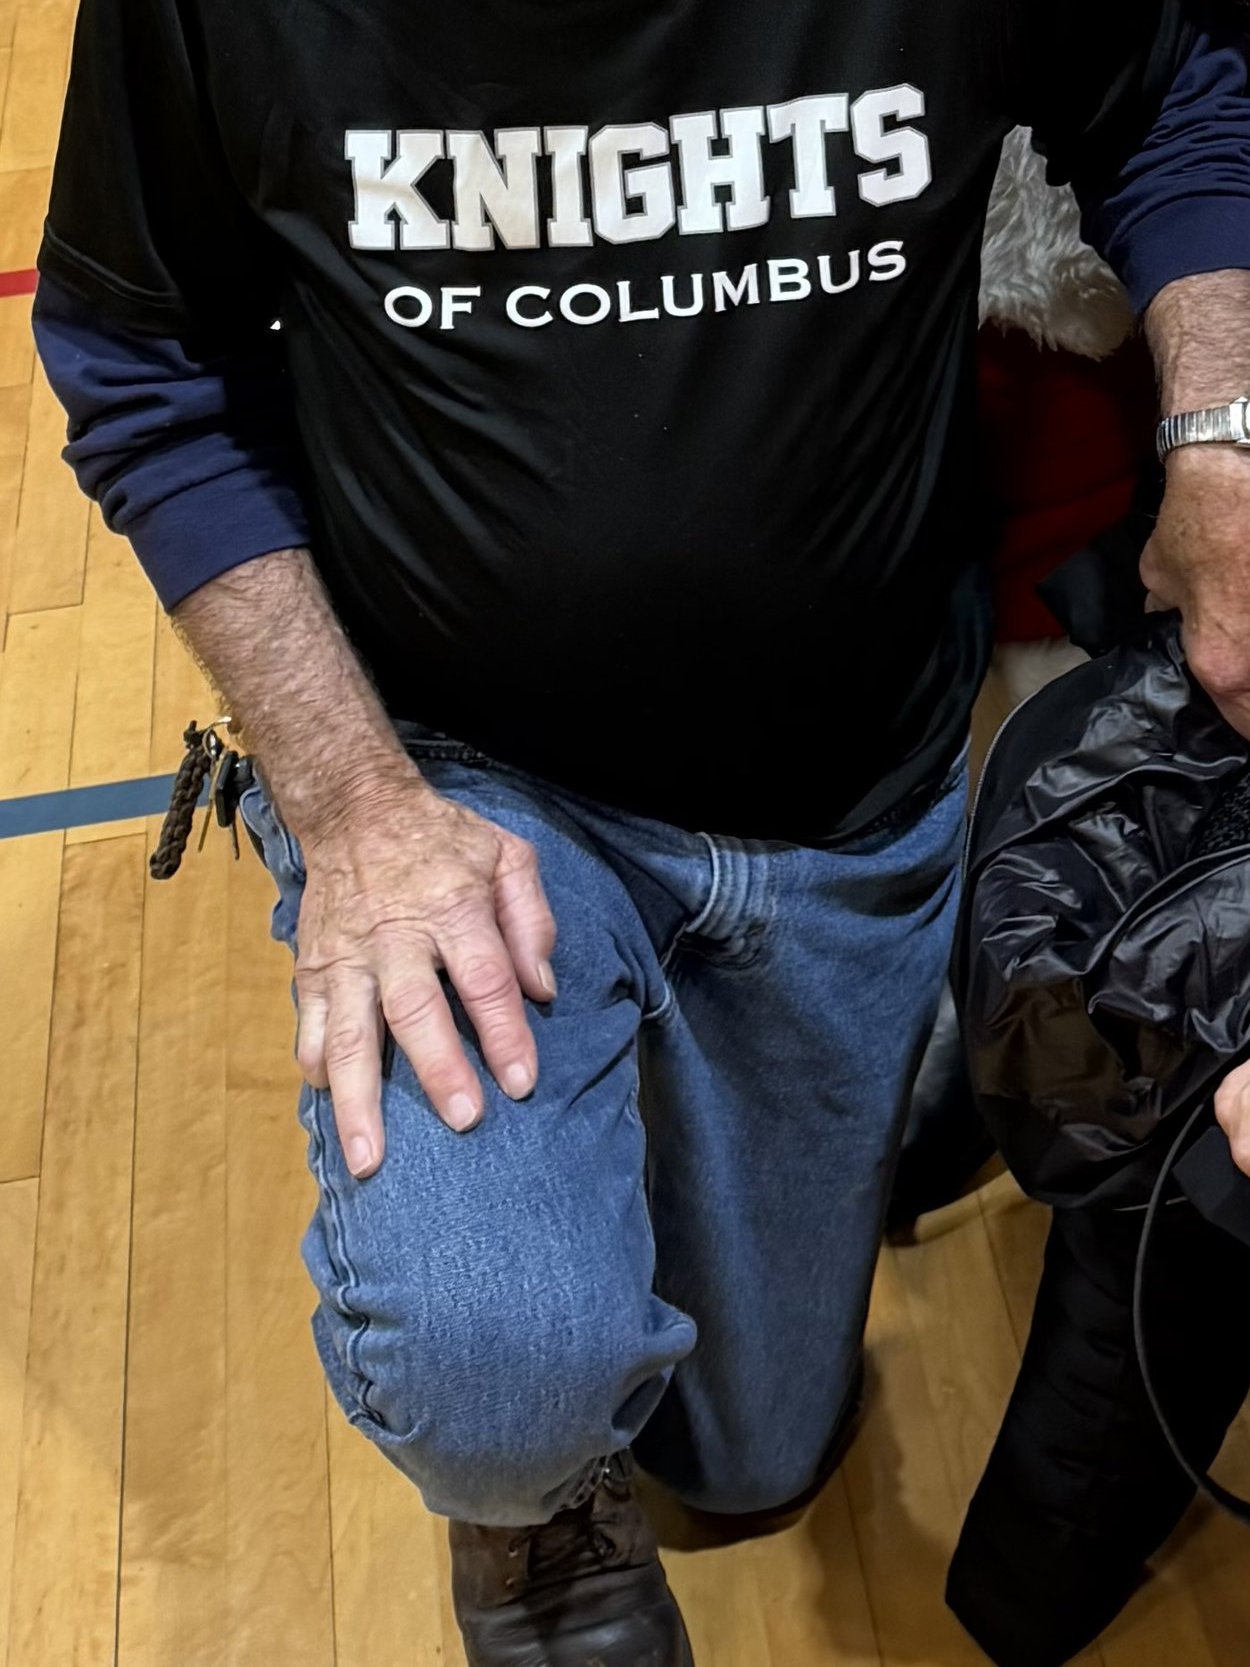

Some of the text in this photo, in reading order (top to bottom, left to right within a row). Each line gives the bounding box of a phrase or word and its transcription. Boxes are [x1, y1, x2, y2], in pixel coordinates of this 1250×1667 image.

[344, 83, 933, 251] KNIGHTS
[383, 240, 907, 330] OF COLUMBUS
